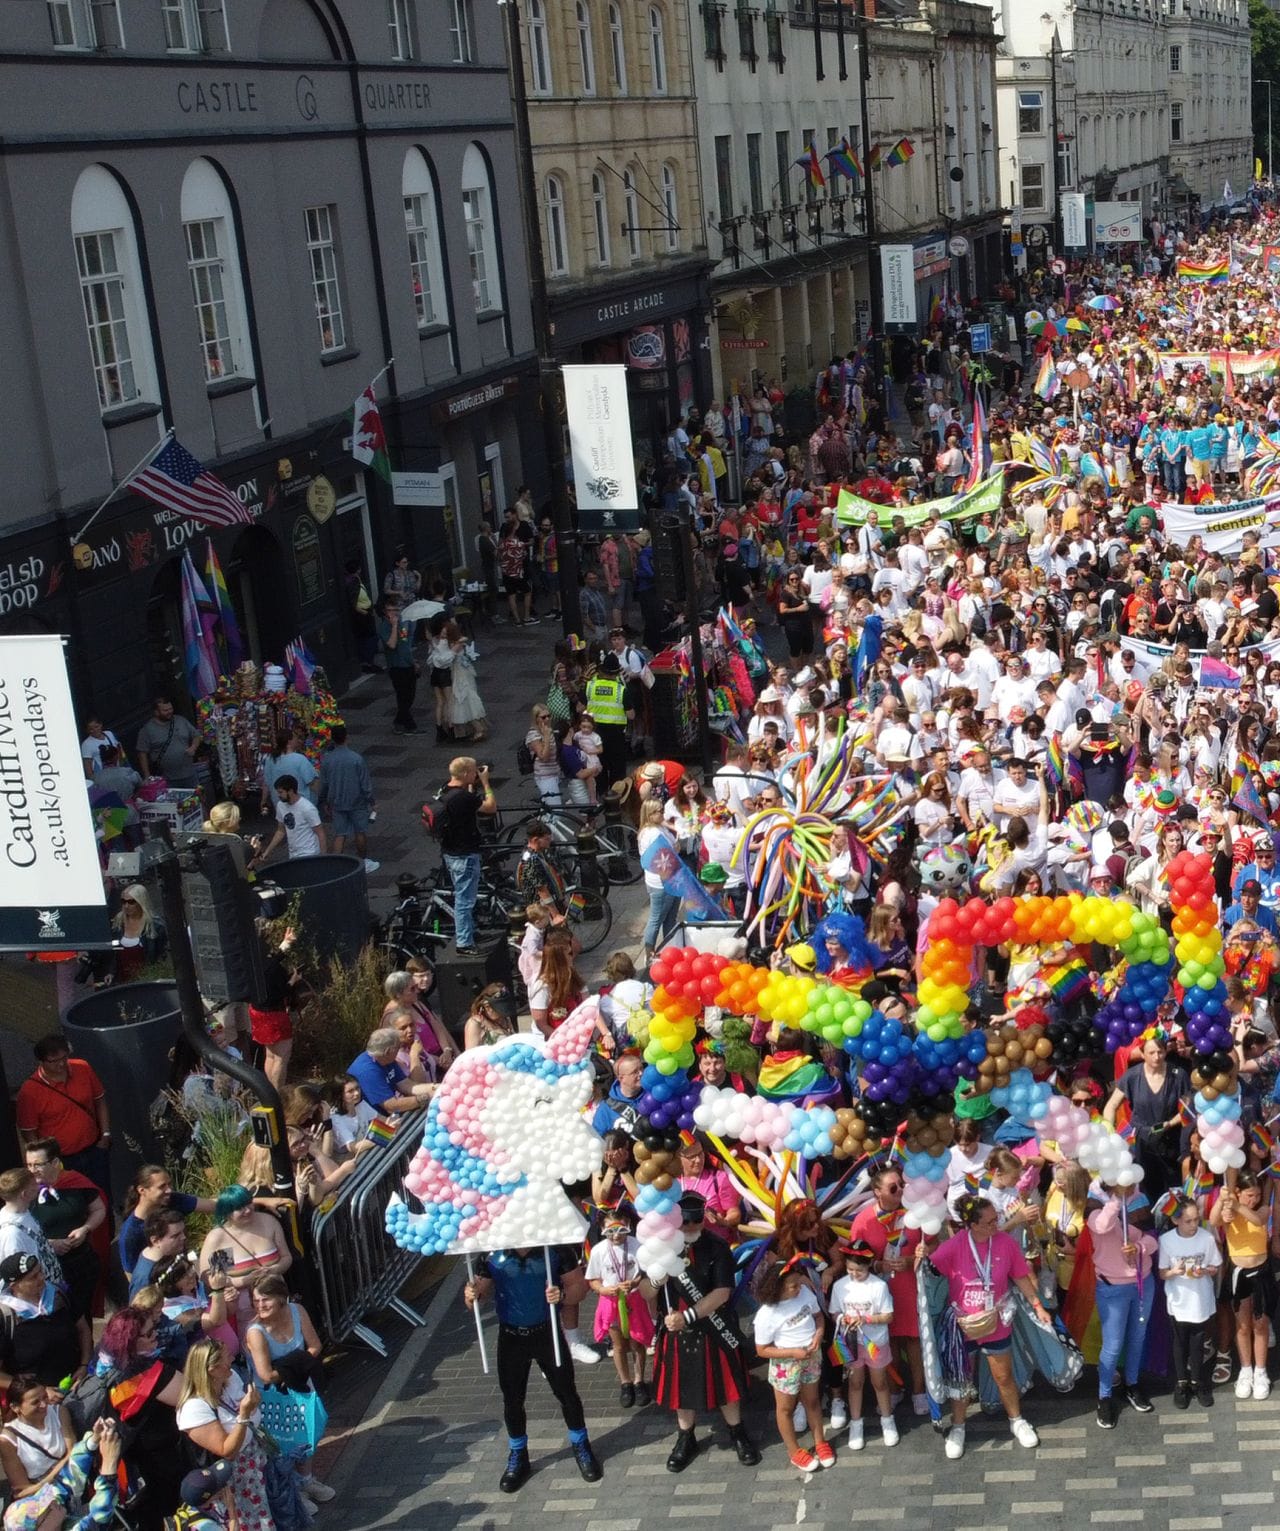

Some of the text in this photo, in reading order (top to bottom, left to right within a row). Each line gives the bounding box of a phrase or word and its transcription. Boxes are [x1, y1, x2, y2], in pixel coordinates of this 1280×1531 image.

[177, 82, 258, 113] CASTLE
[365, 83, 432, 110] QUARTER
[598, 292, 664, 321] CASTLE ARCADE
[449, 390, 486, 414] PORTUGUESE
[592, 447, 600, 471] Cardiff
[1195, 498, 1265, 516] Celebrate
[1205, 514, 1267, 533] Identity
[92, 537, 121, 571] AND
[22, 677, 71, 868] .ac.uk/opendays
[678, 1271, 703, 1303] EATHE
[721, 1329, 740, 1350] 2023
